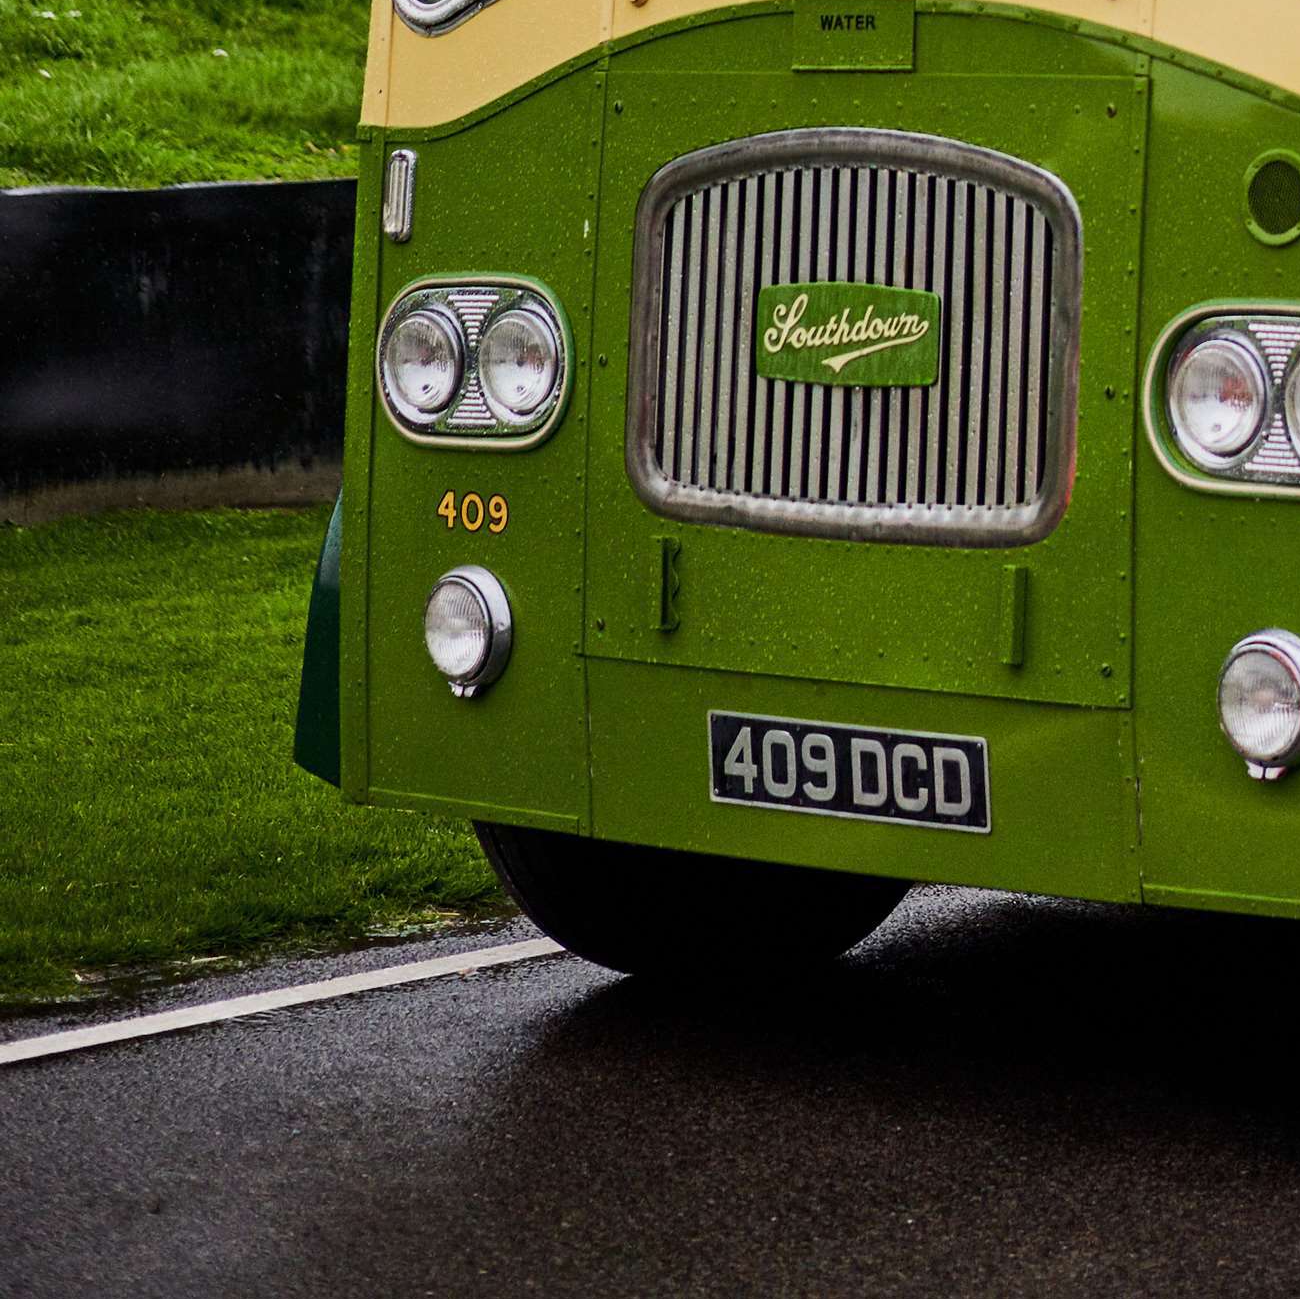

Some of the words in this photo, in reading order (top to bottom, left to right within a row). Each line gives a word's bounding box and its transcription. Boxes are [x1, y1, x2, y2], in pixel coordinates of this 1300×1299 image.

[820, 14, 876, 31] WATER
[763, 293, 930, 354] Southdown
[437, 489, 509, 533] 409
[723, 726, 837, 802] 409
[850, 737, 973, 817] DCD
